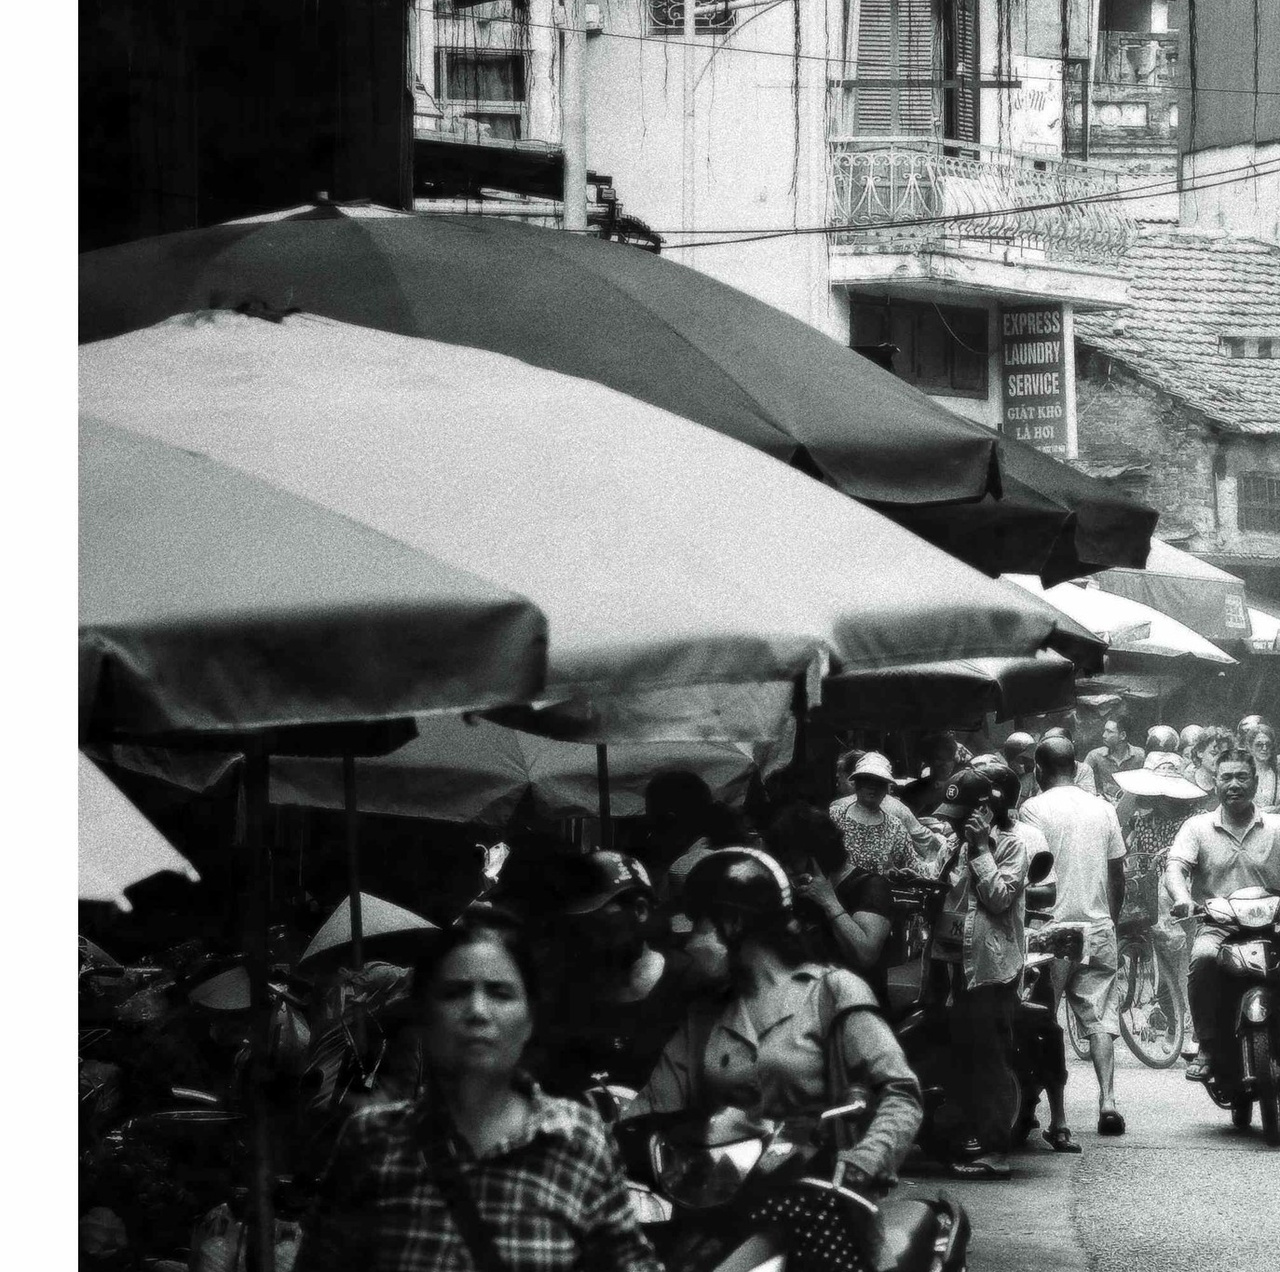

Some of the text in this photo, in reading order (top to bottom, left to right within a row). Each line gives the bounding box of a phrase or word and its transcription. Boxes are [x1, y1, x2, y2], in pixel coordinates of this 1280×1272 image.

[1003, 310, 1061, 336] EXPRESS
[1004, 341, 1061, 366] LAUNDRY
[1008, 372, 1060, 397] SERVICE
[1037, 401, 1063, 419] KHÔ
